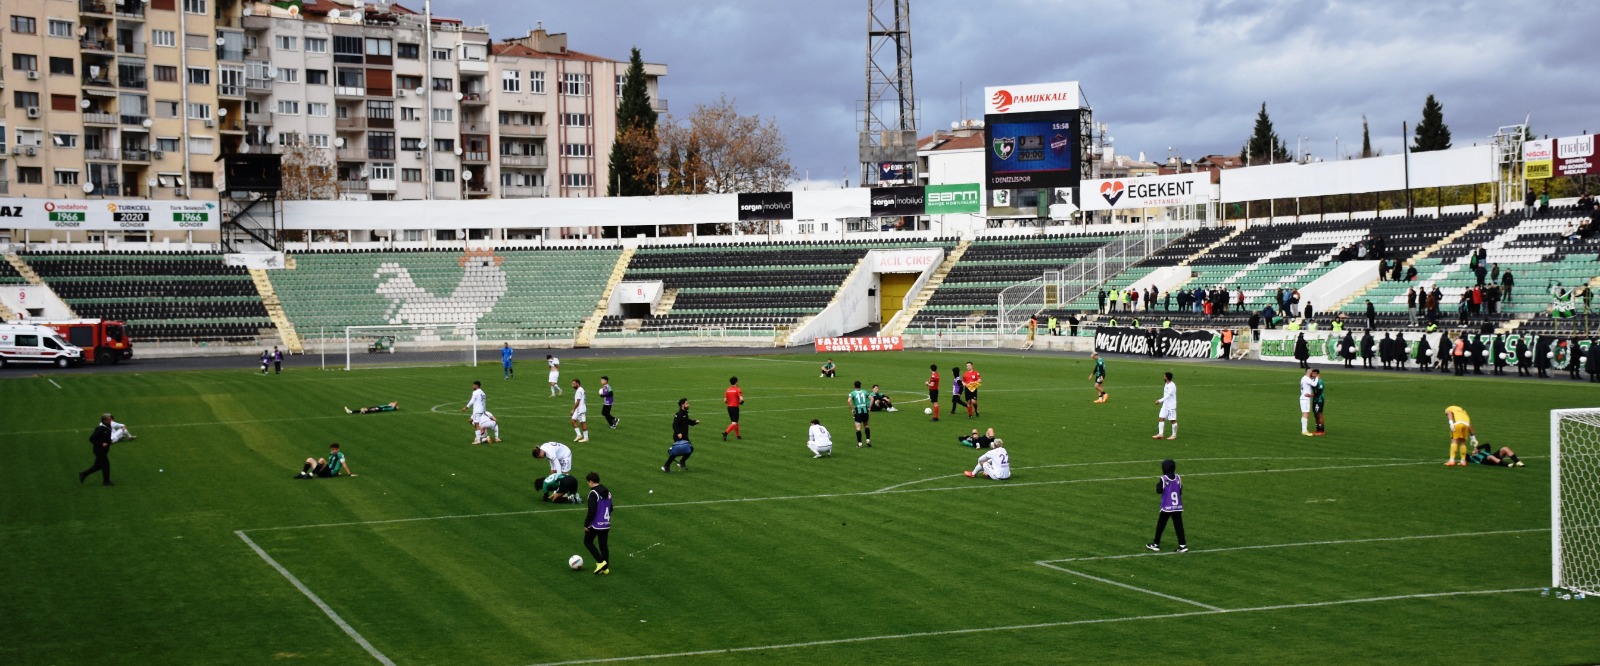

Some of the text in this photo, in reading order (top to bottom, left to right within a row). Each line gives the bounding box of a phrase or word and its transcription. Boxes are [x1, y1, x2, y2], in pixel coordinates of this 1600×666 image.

[1013, 92, 1068, 104] PAMUKKALE
[1052, 123, 1070, 131] 15:58
[1128, 181, 1194, 199] EGEKENT
[896, 196, 923, 206] mobilya
[56, 202, 89, 211] vodafone
[764, 202, 791, 211] mobilya
[57, 213, 79, 222] 1966
[120, 213, 144, 222] 2020
[181, 213, 202, 222] 1966
[19, 291, 26, 300] 9
[1095, 331, 1121, 352] MAZİ
[1166, 337, 1211, 358] YARADIR
[855, 392, 866, 404] 11
[1170, 491, 1179, 506] 9
[603, 506, 611, 522] 4
